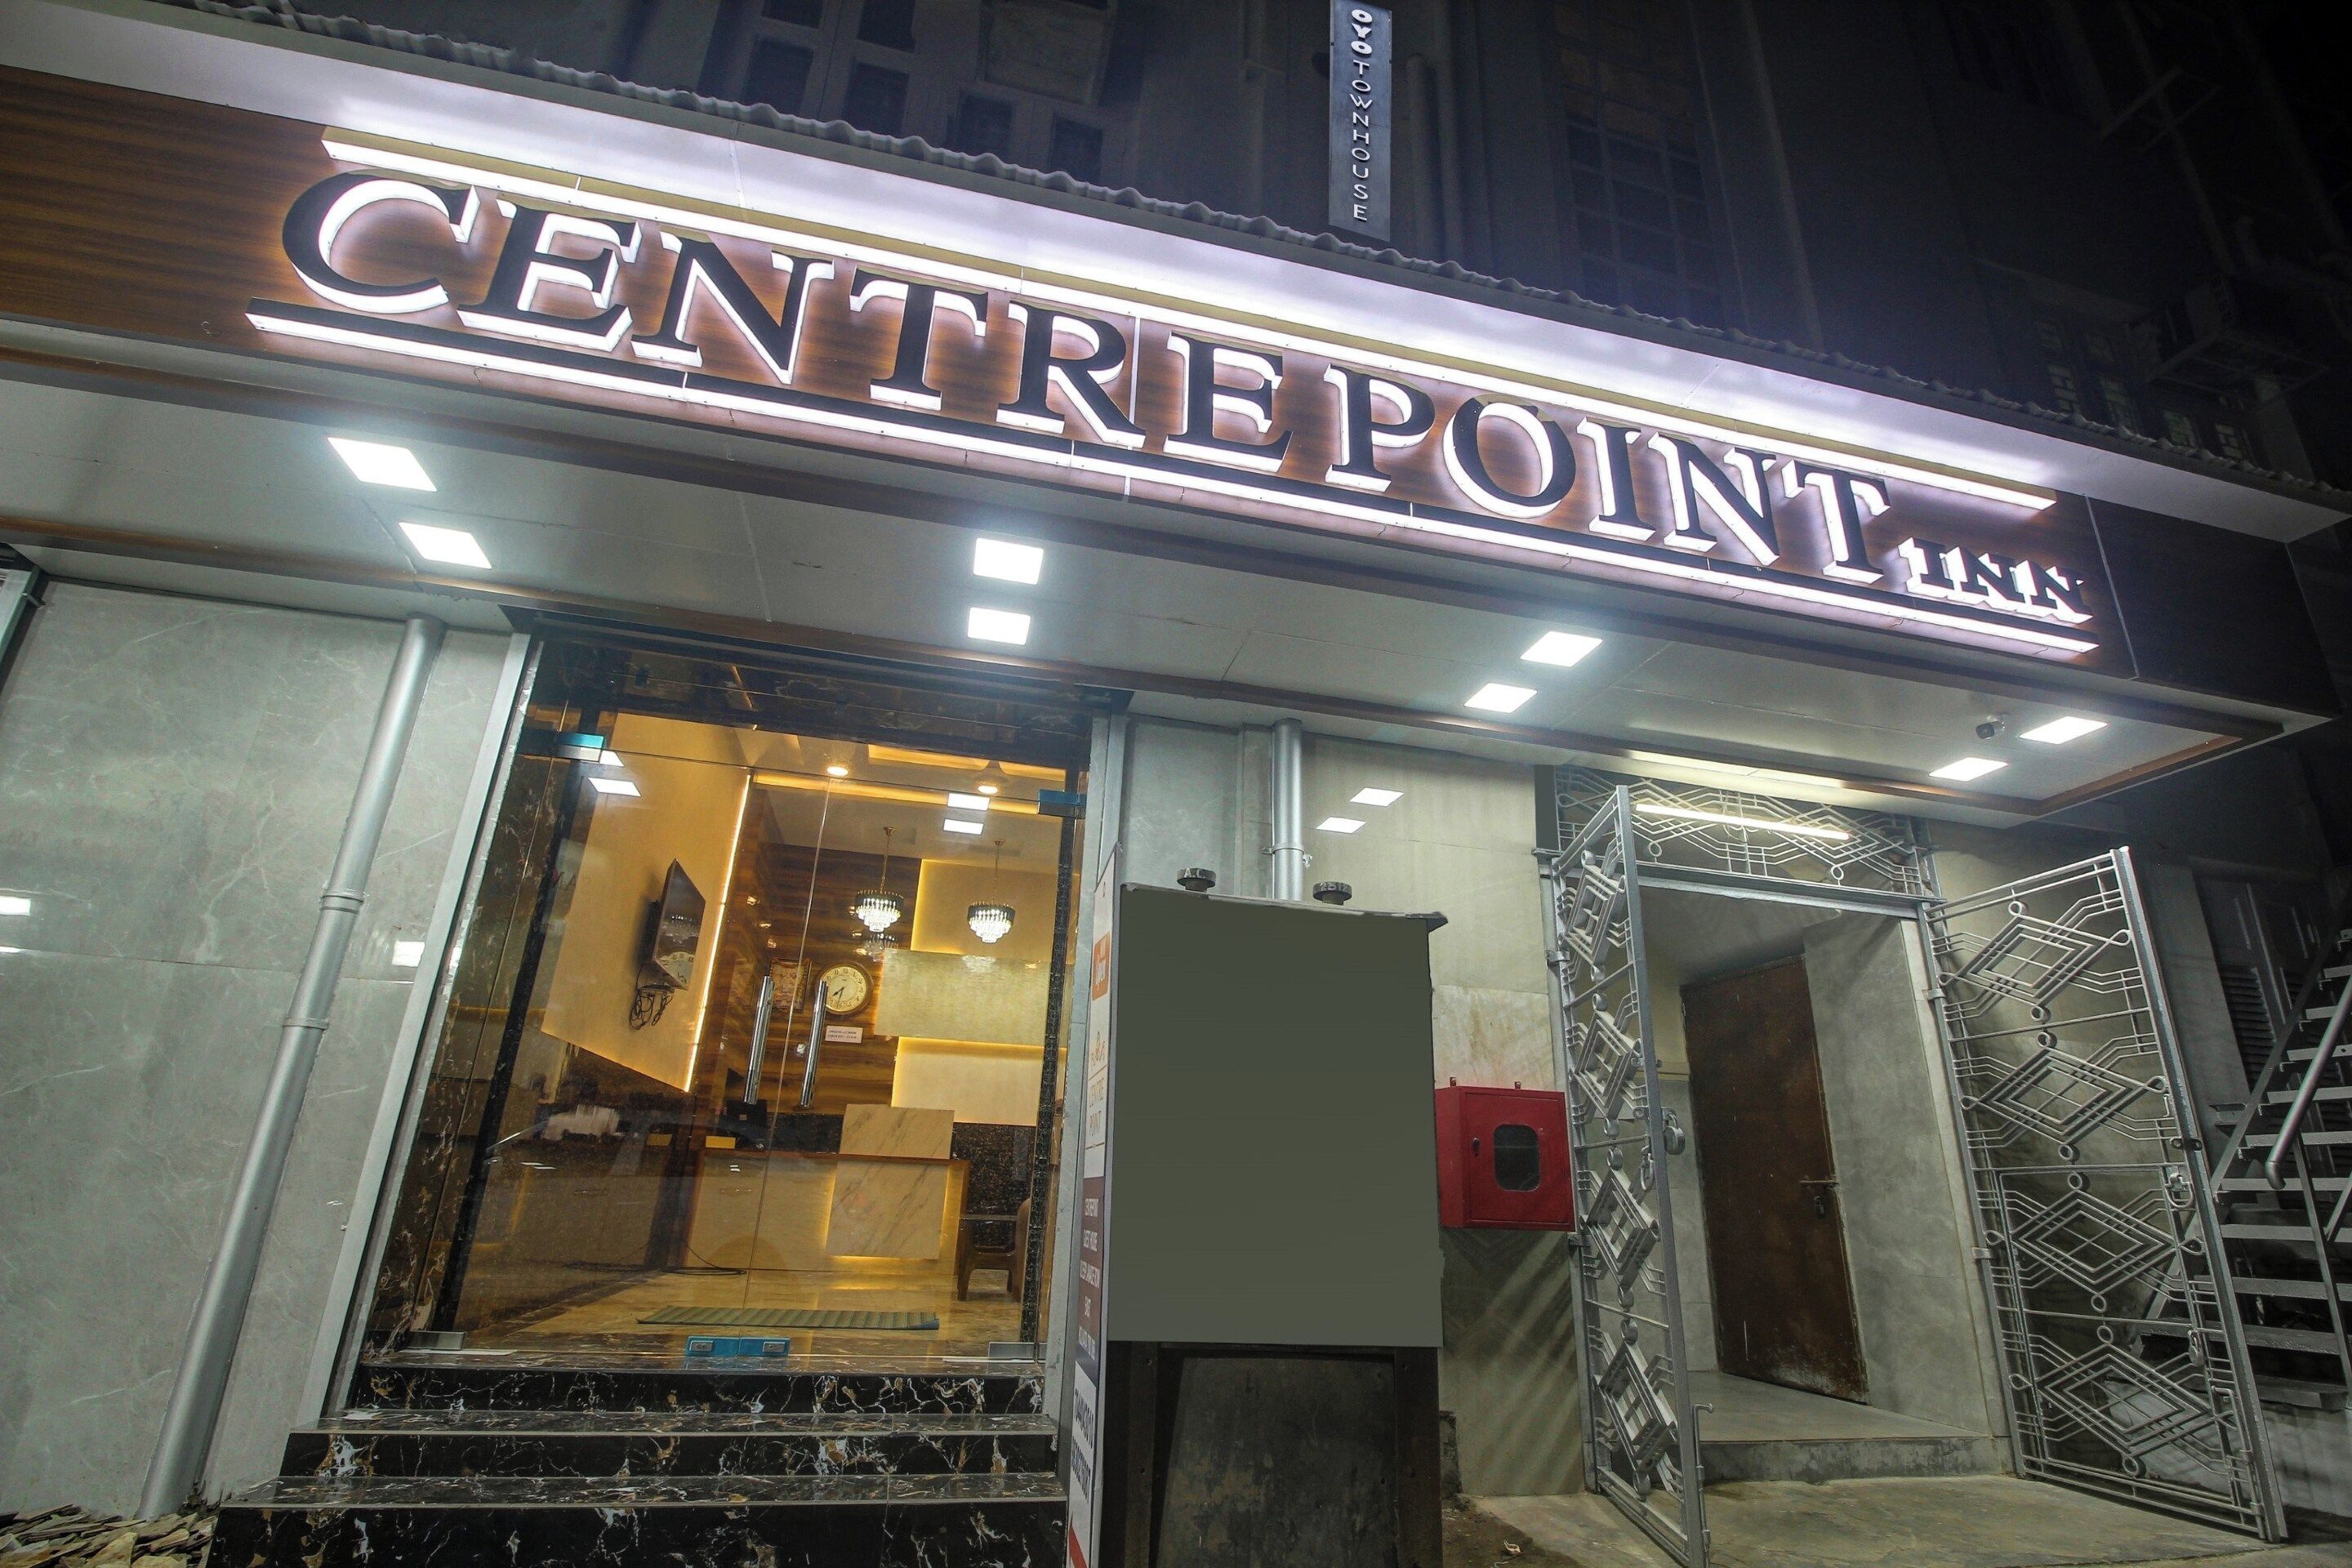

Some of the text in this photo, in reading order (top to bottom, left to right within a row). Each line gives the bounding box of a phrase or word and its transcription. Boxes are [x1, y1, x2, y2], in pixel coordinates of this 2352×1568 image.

[1349, 8, 1374, 222] OYO TOWNHOUSE
[1897, 536, 2094, 624] INN
